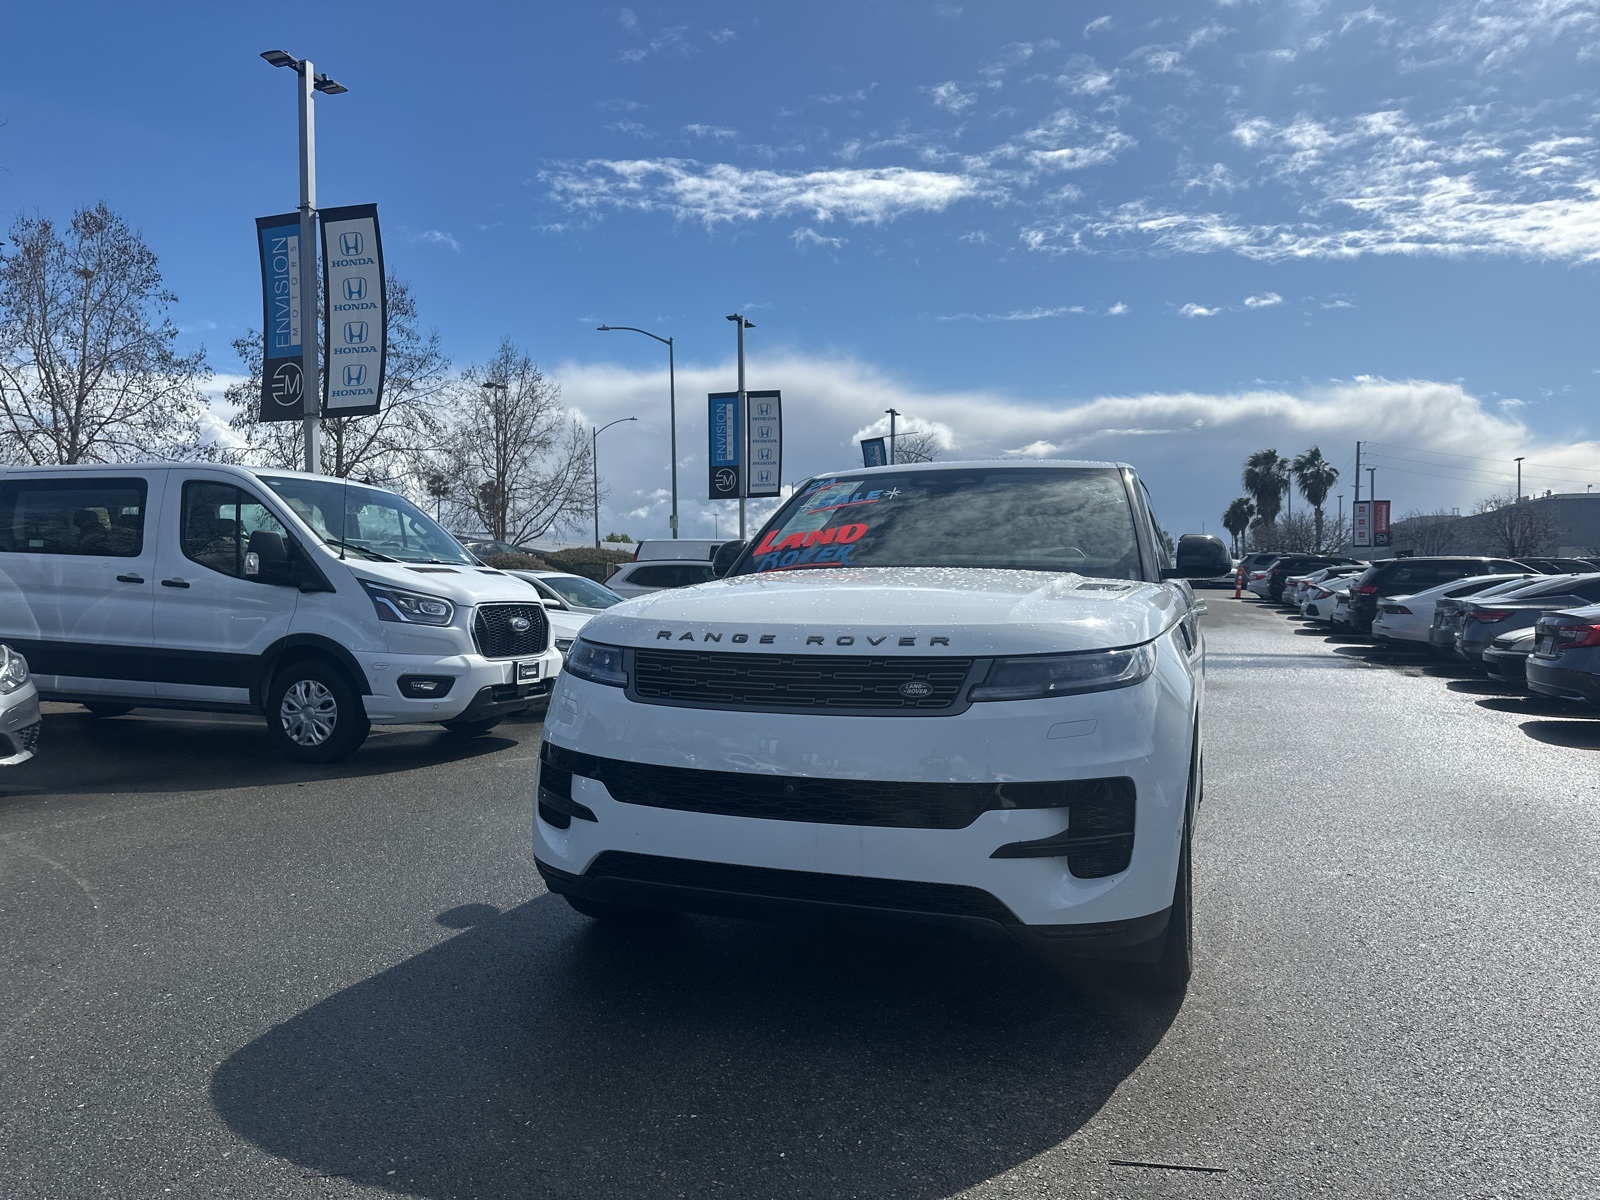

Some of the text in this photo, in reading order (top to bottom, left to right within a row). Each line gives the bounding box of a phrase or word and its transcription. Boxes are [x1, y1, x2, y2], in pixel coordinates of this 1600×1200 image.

[331, 257, 375, 268] HONDA
[271, 236, 290, 348] ENVISION
[290, 245, 300, 337] MOTORS
[333, 302, 378, 312] HONDA
[333, 345, 378, 355] HONDA
[331, 387, 374, 397] HONDA
[716, 403, 727, 461] ENVISION
[752, 523, 869, 556] LAND
[756, 544, 857, 573] ROVER
[656, 630, 950, 647] RANGE ROVER
